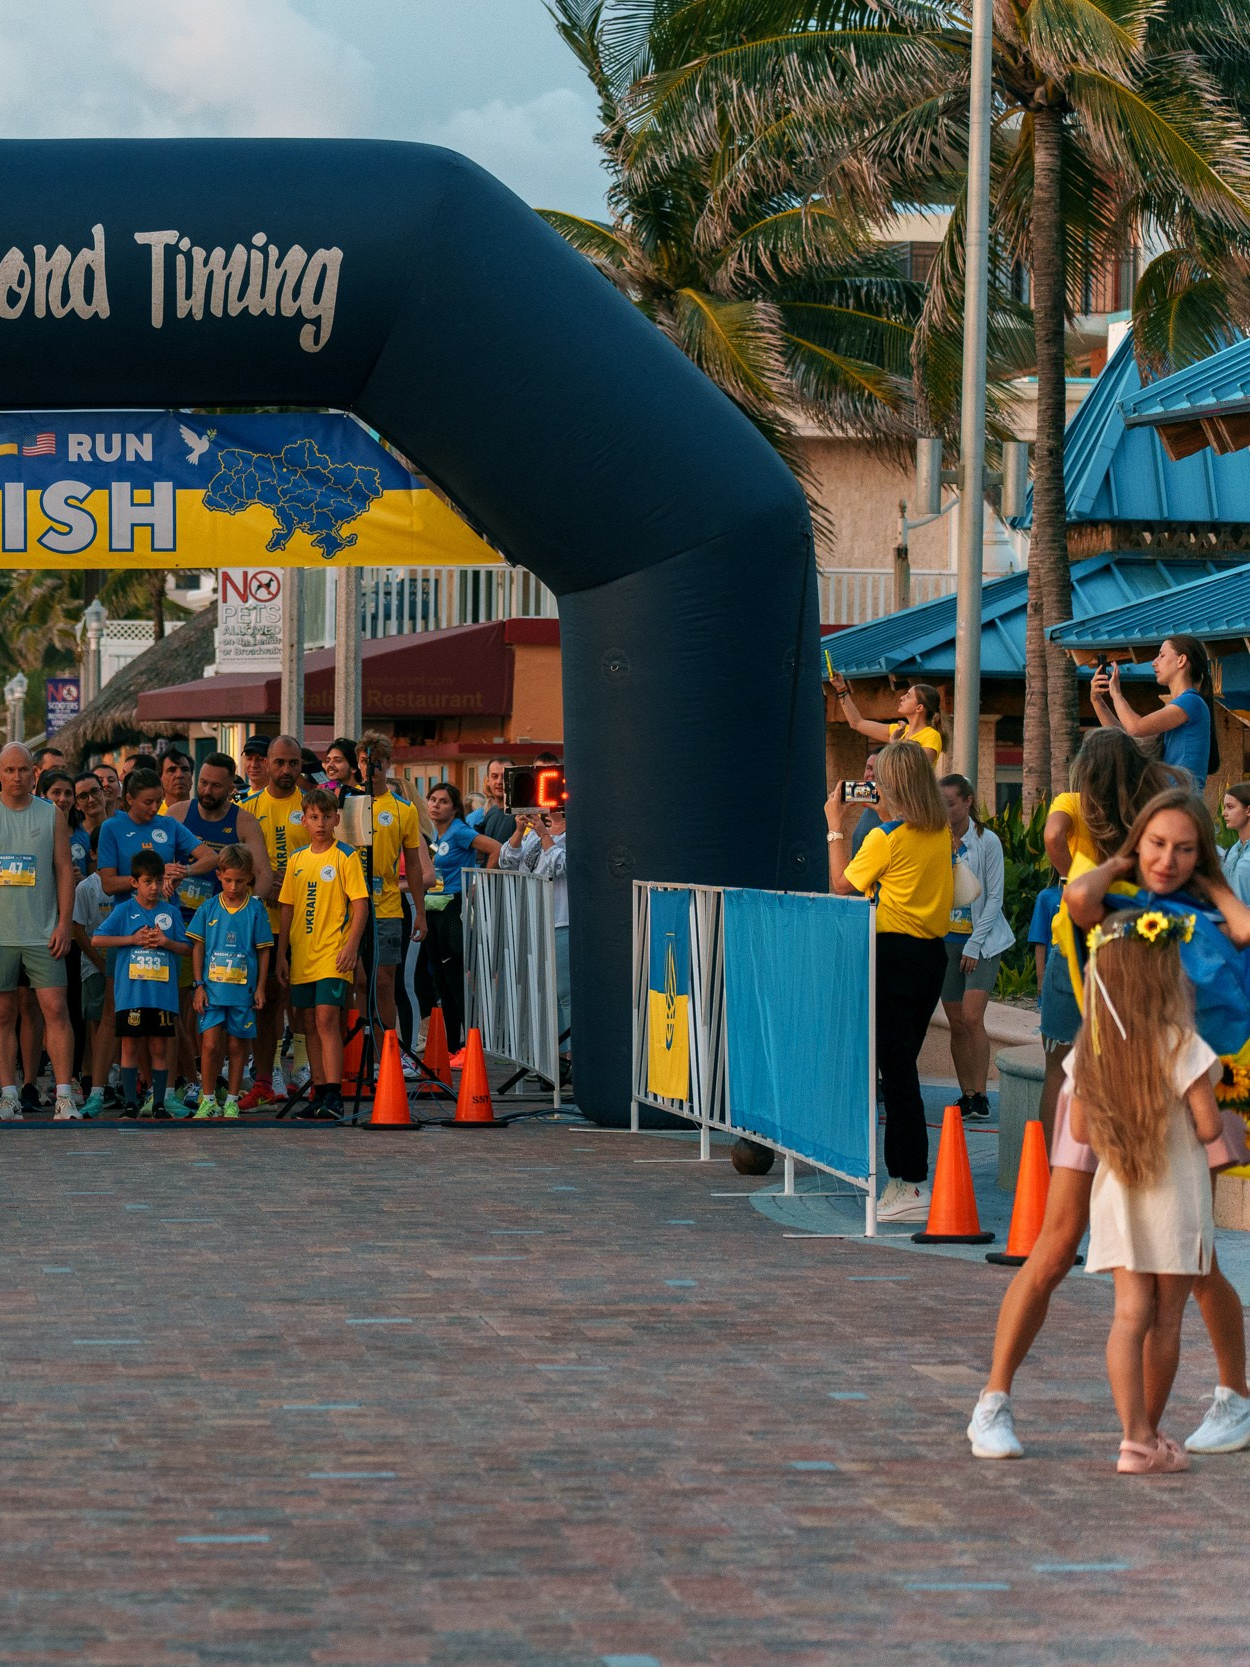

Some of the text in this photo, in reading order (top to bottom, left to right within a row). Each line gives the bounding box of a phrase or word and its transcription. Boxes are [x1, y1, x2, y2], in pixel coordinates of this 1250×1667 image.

[133, 230, 344, 354] Timing
[68, 433, 153, 462] RUN
[221, 604, 282, 624] PETS
[222, 625, 282, 636] ALLOWED
[366, 689, 484, 708] Restaurant
[275, 825, 288, 871] KRAINE
[9, 861, 23, 876] 47
[306, 881, 317, 934] UKRAINE
[136, 956, 161, 971] 333
[225, 959, 233, 972] 7
